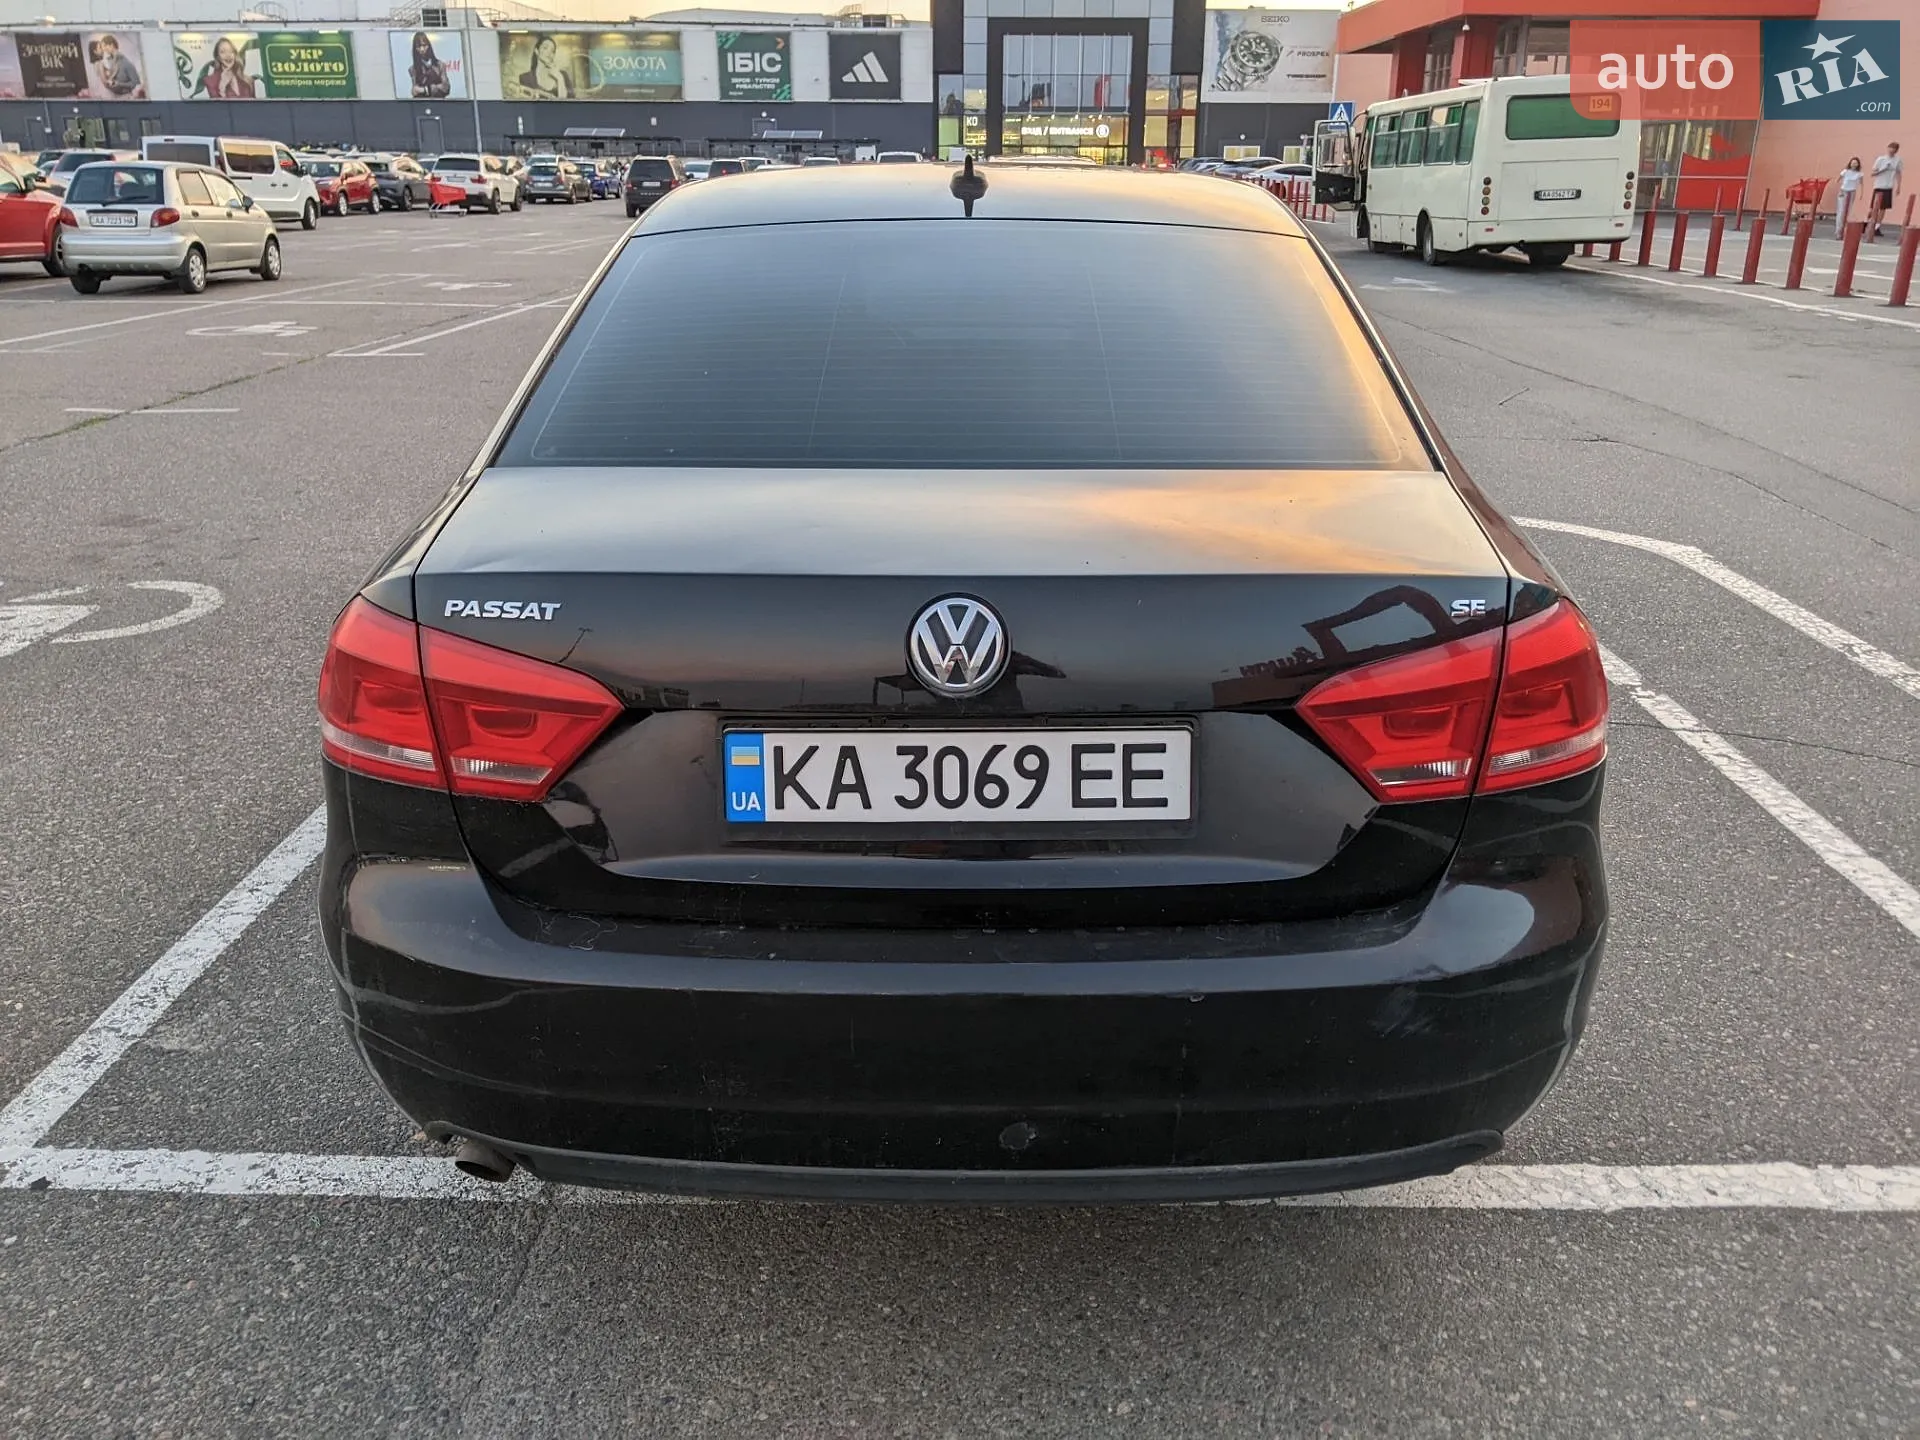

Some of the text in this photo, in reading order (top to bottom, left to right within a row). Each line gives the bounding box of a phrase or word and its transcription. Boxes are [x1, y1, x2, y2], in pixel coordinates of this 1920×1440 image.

[1261, 15, 1290, 23] SEIKO
[289, 48, 323, 60] УКР
[727, 52, 782, 73] ІБІС
[271, 61, 345, 73] ЗОЛОТО
[603, 55, 667, 71] ЗОЛОТА
[1591, 98, 1610, 109] 194
[444, 600, 561, 620] PASSAT
[1451, 599, 1486, 617] SE
[773, 743, 1168, 810] KA 3069 EE
[731, 792, 761, 811] UA
